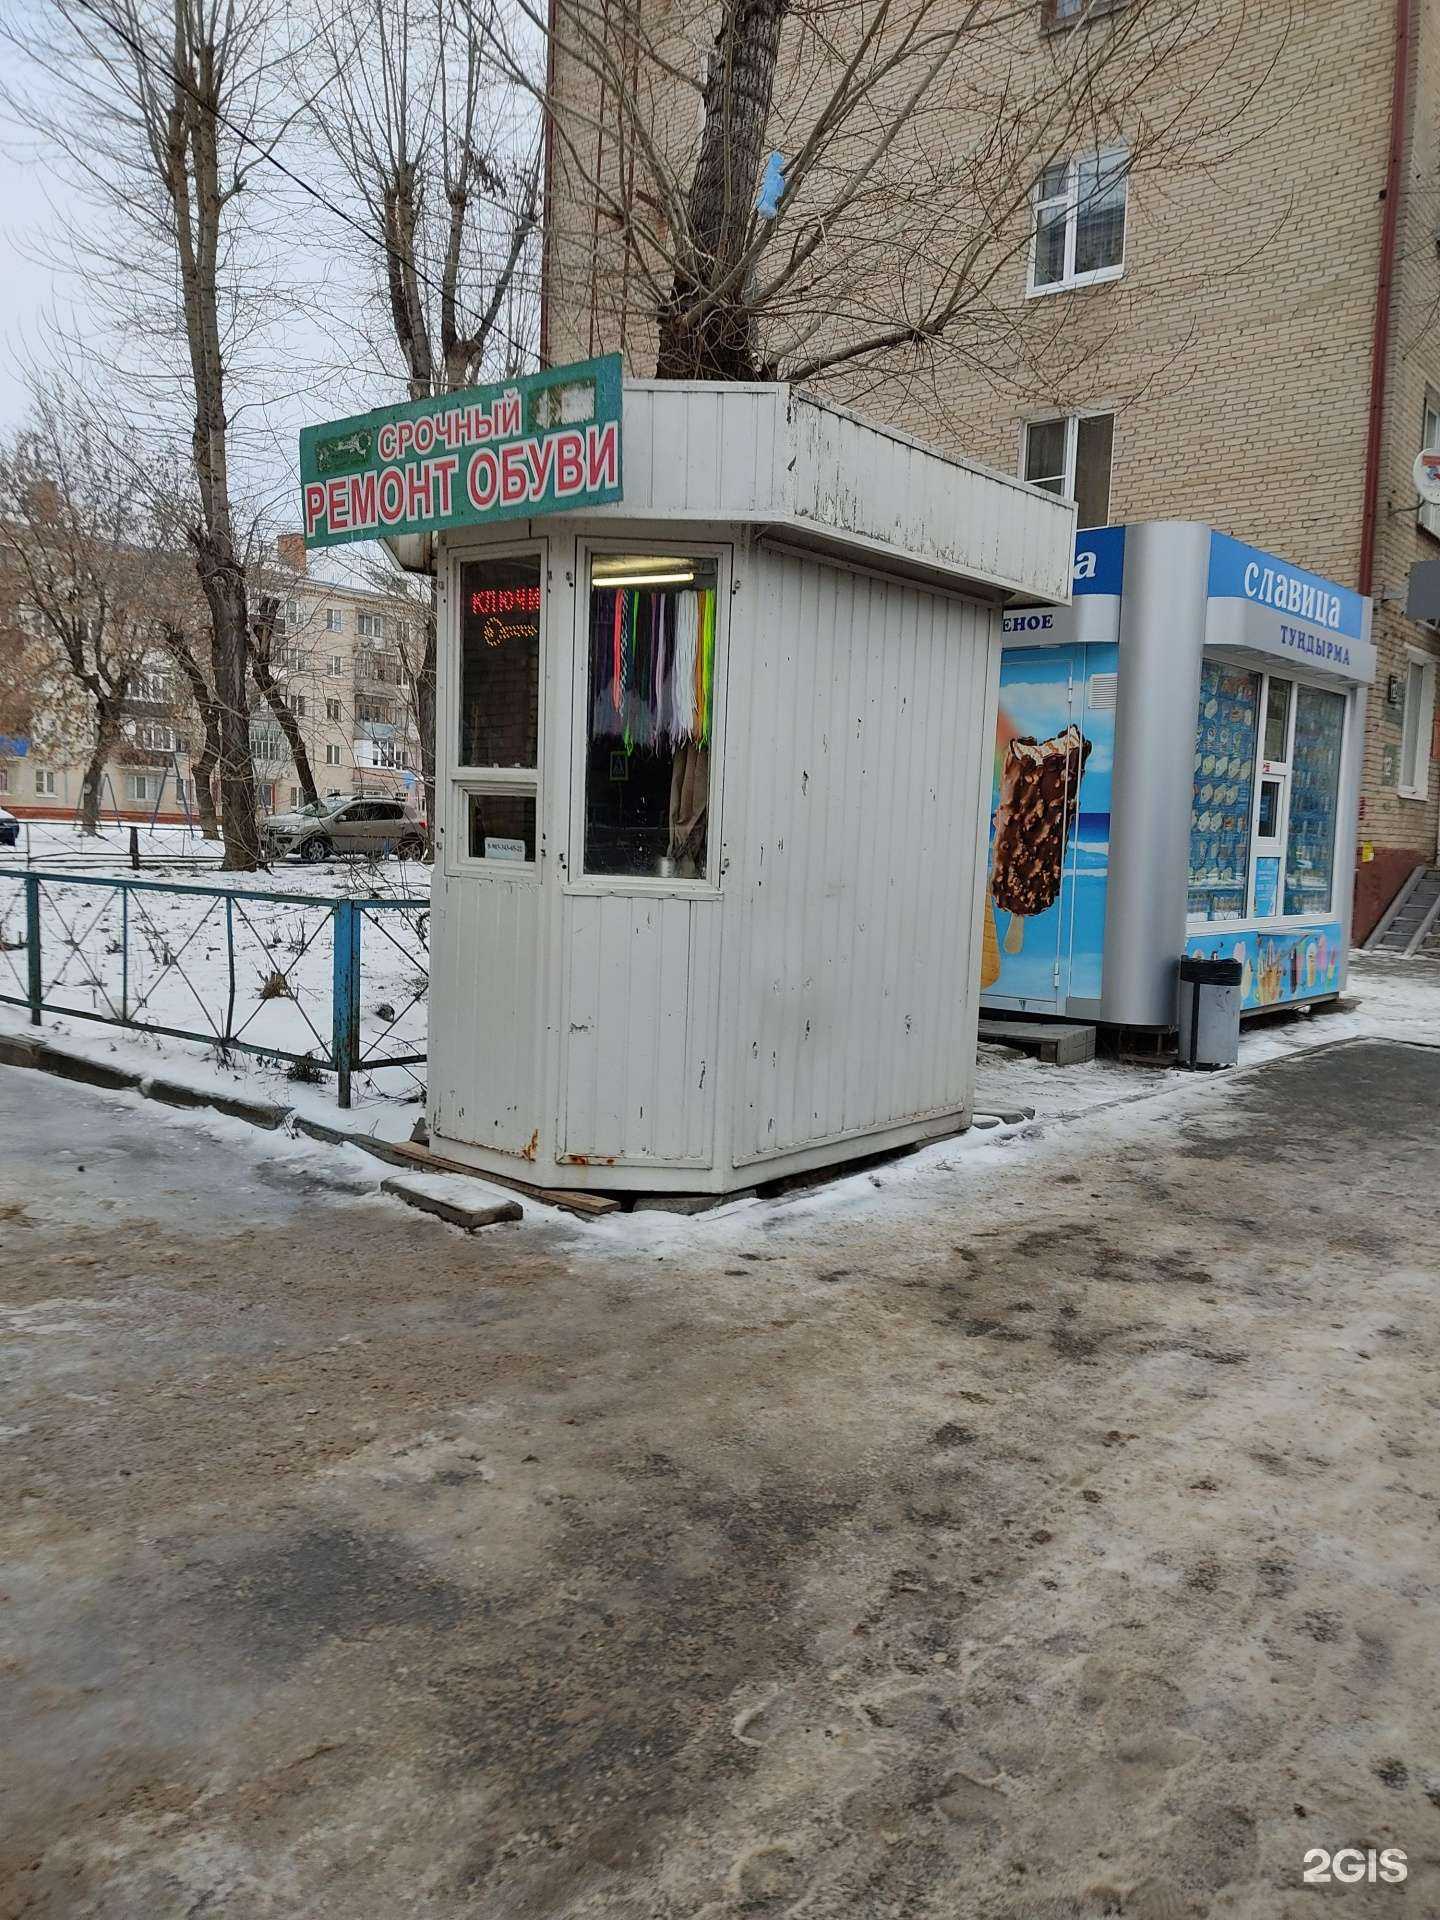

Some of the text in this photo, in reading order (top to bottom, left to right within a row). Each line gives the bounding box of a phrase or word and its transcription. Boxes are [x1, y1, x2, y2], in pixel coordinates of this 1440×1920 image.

[378, 388, 522, 461] СРОЧНЫЙ
[305, 421, 619, 537] РЕМОНТ ОБУВИ
[472, 587, 541, 615] КЛЮЧИ
[1002, 614, 1054, 633] ЕНОЕ
